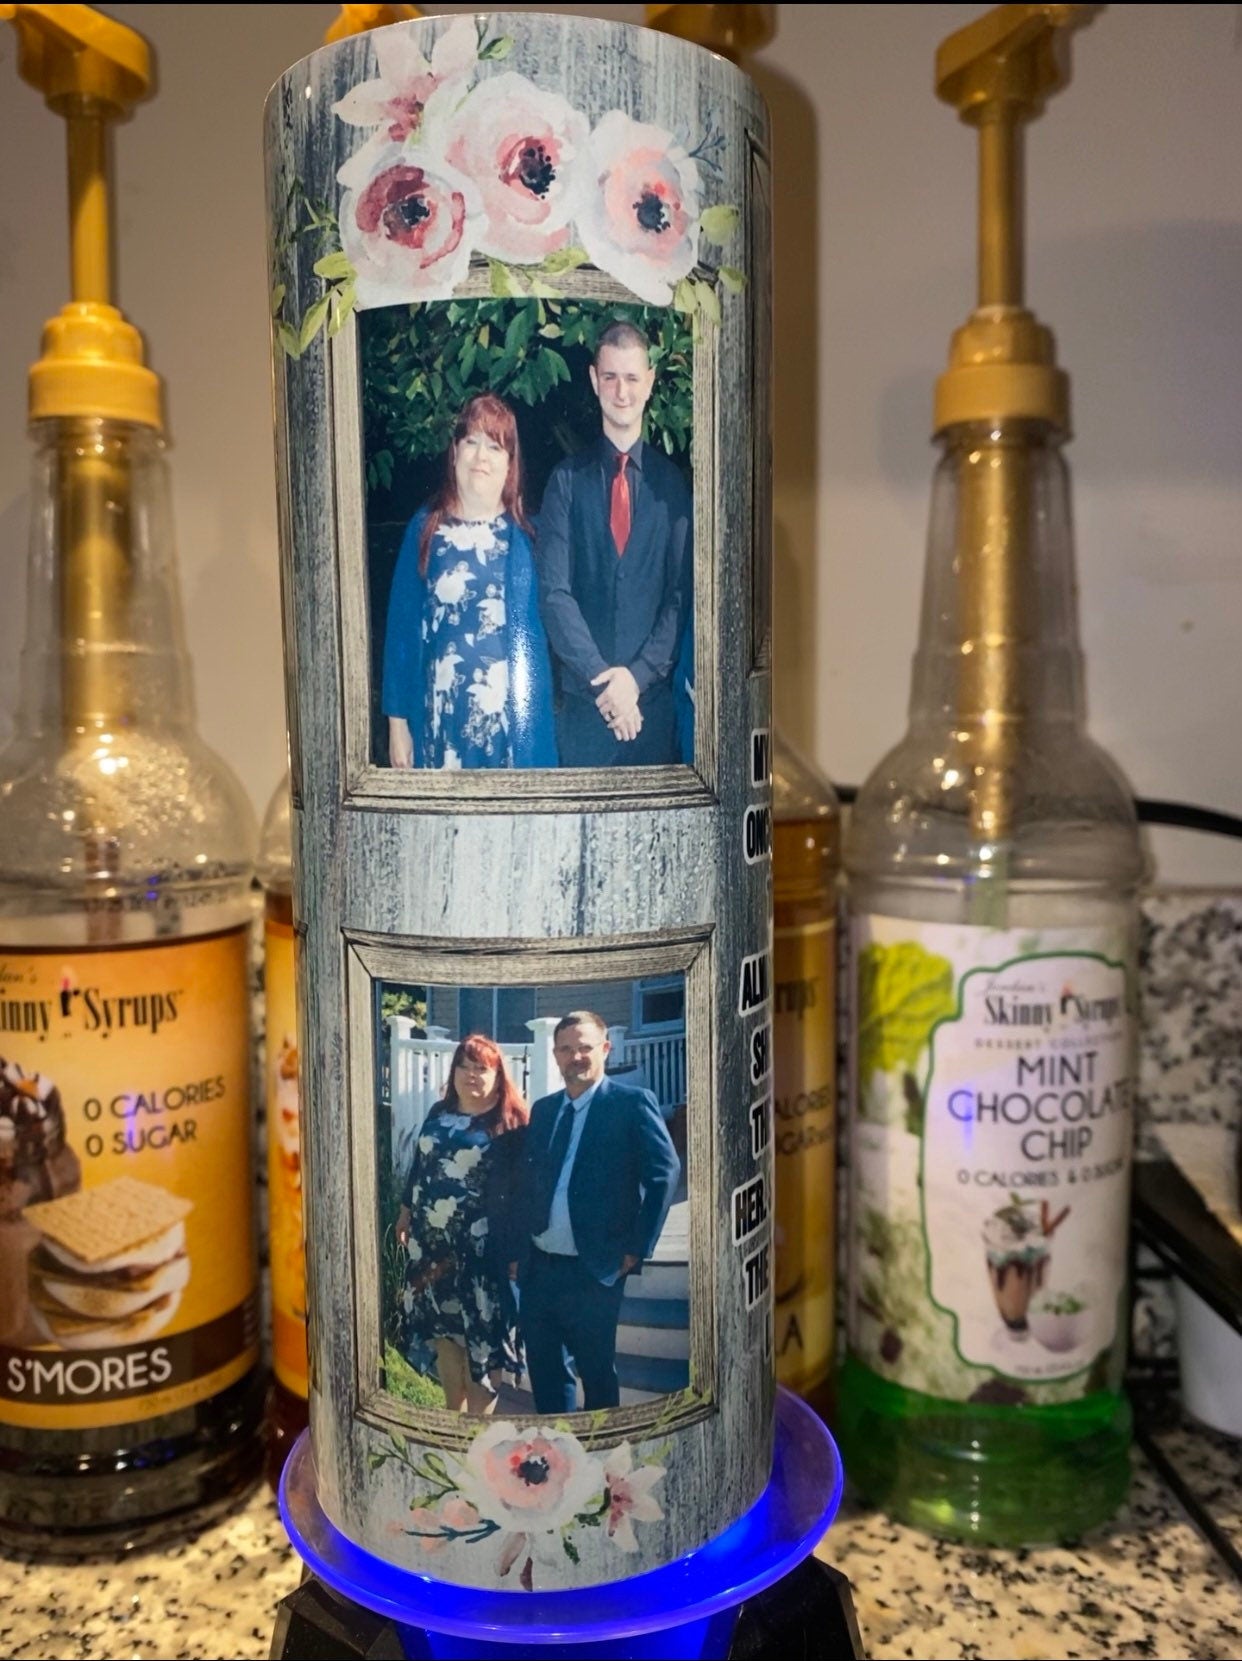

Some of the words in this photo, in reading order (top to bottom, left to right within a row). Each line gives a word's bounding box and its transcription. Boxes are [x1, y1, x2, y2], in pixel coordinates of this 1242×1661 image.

[84, 988, 178, 1039] Syrups
[985, 995, 1053, 1033] Skinny
[1016, 1051, 1099, 1087] MINT
[110, 1076, 227, 1120] CALORIES
[112, 1120, 197, 1155] SUGAR
[1020, 1127, 1092, 1162] CHIP
[974, 1169, 1060, 1188] CALORIES
[7, 1347, 173, 1396] S'MORES
